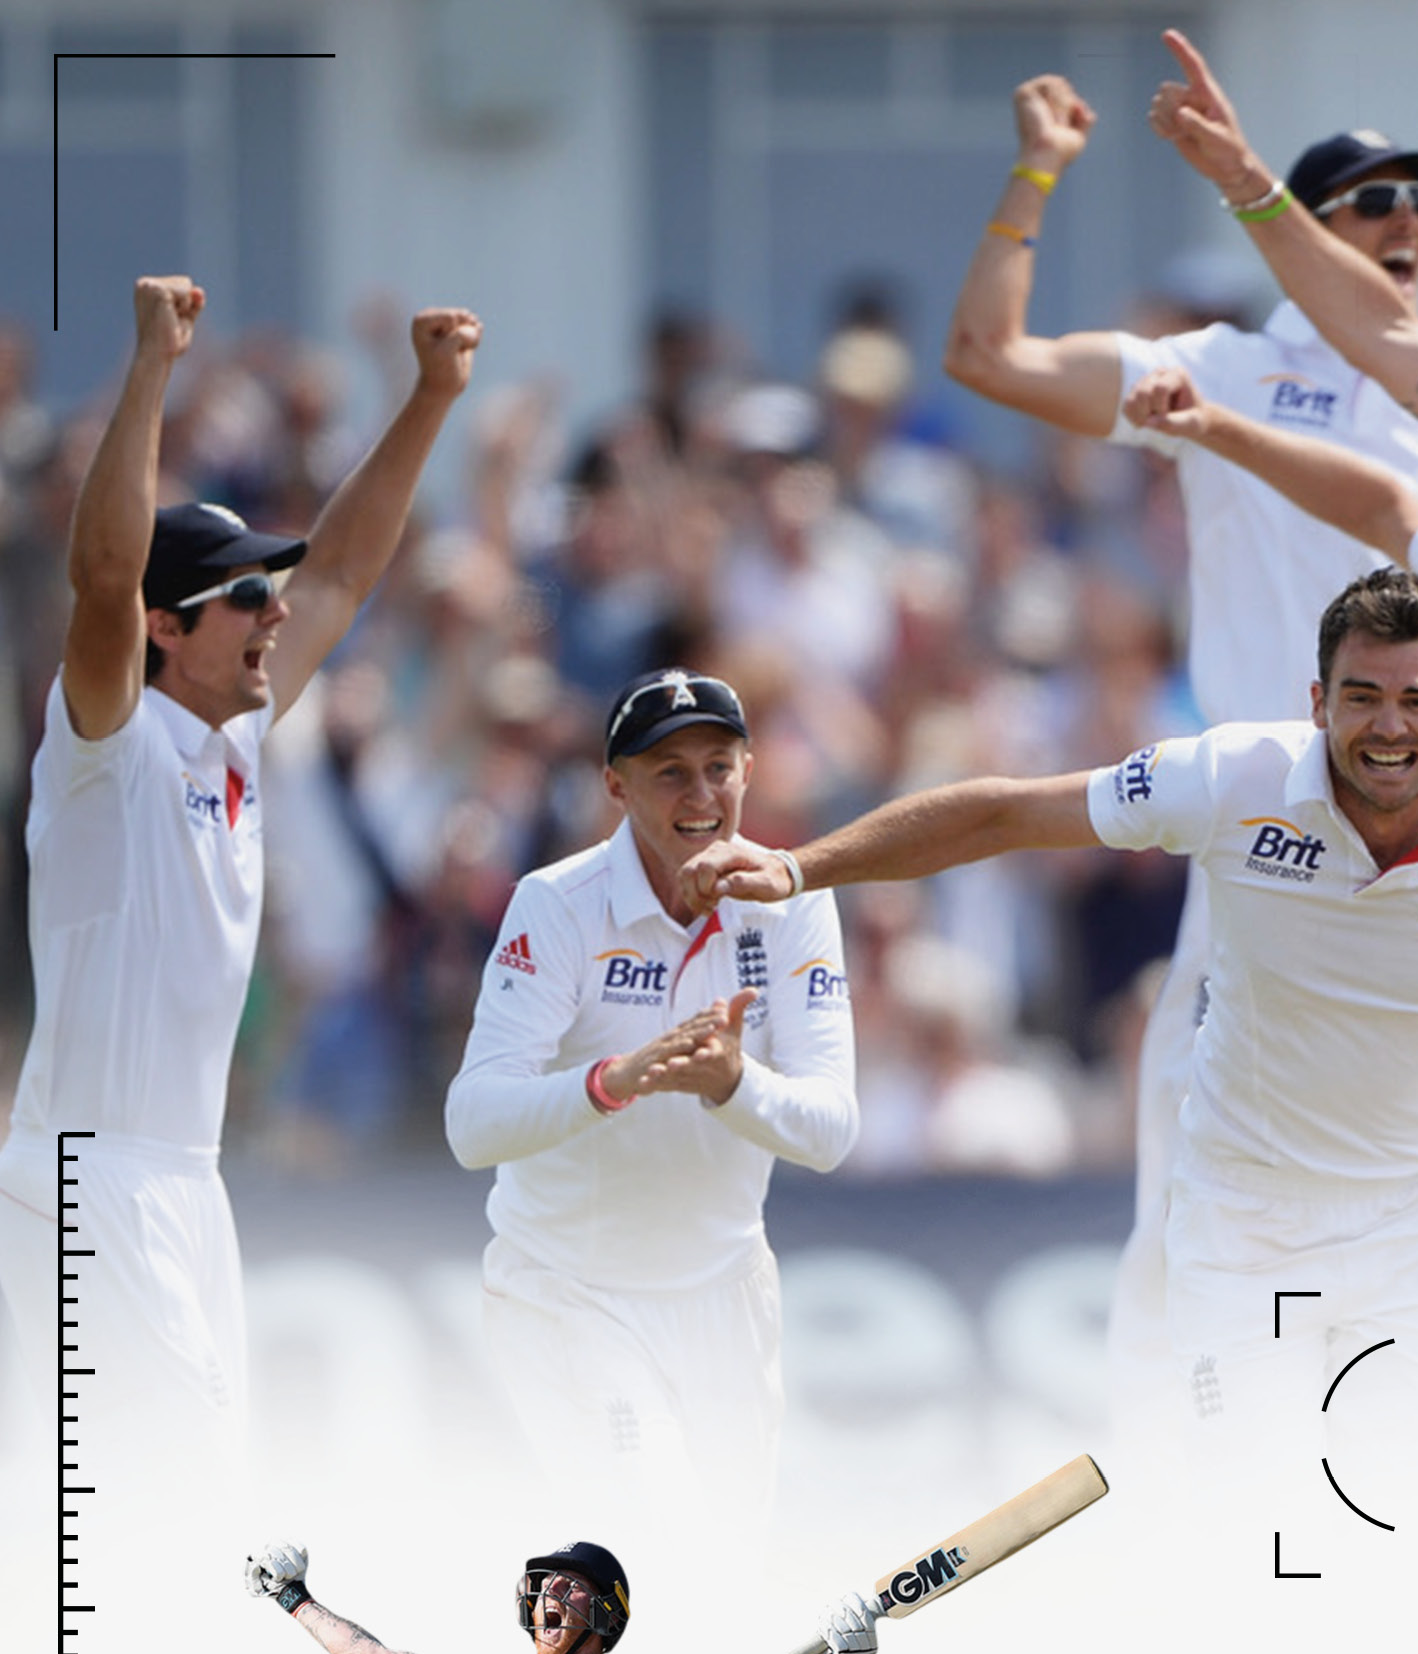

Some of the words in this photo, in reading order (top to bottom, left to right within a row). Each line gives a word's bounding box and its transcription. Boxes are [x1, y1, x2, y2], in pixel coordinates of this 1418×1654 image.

[1251, 825, 1326, 870] Brit
[1245, 857, 1315, 883] Insurance
[604, 956, 668, 992] Brit
[601, 989, 663, 1007] Insurance
[890, 1546, 959, 1606] GM
